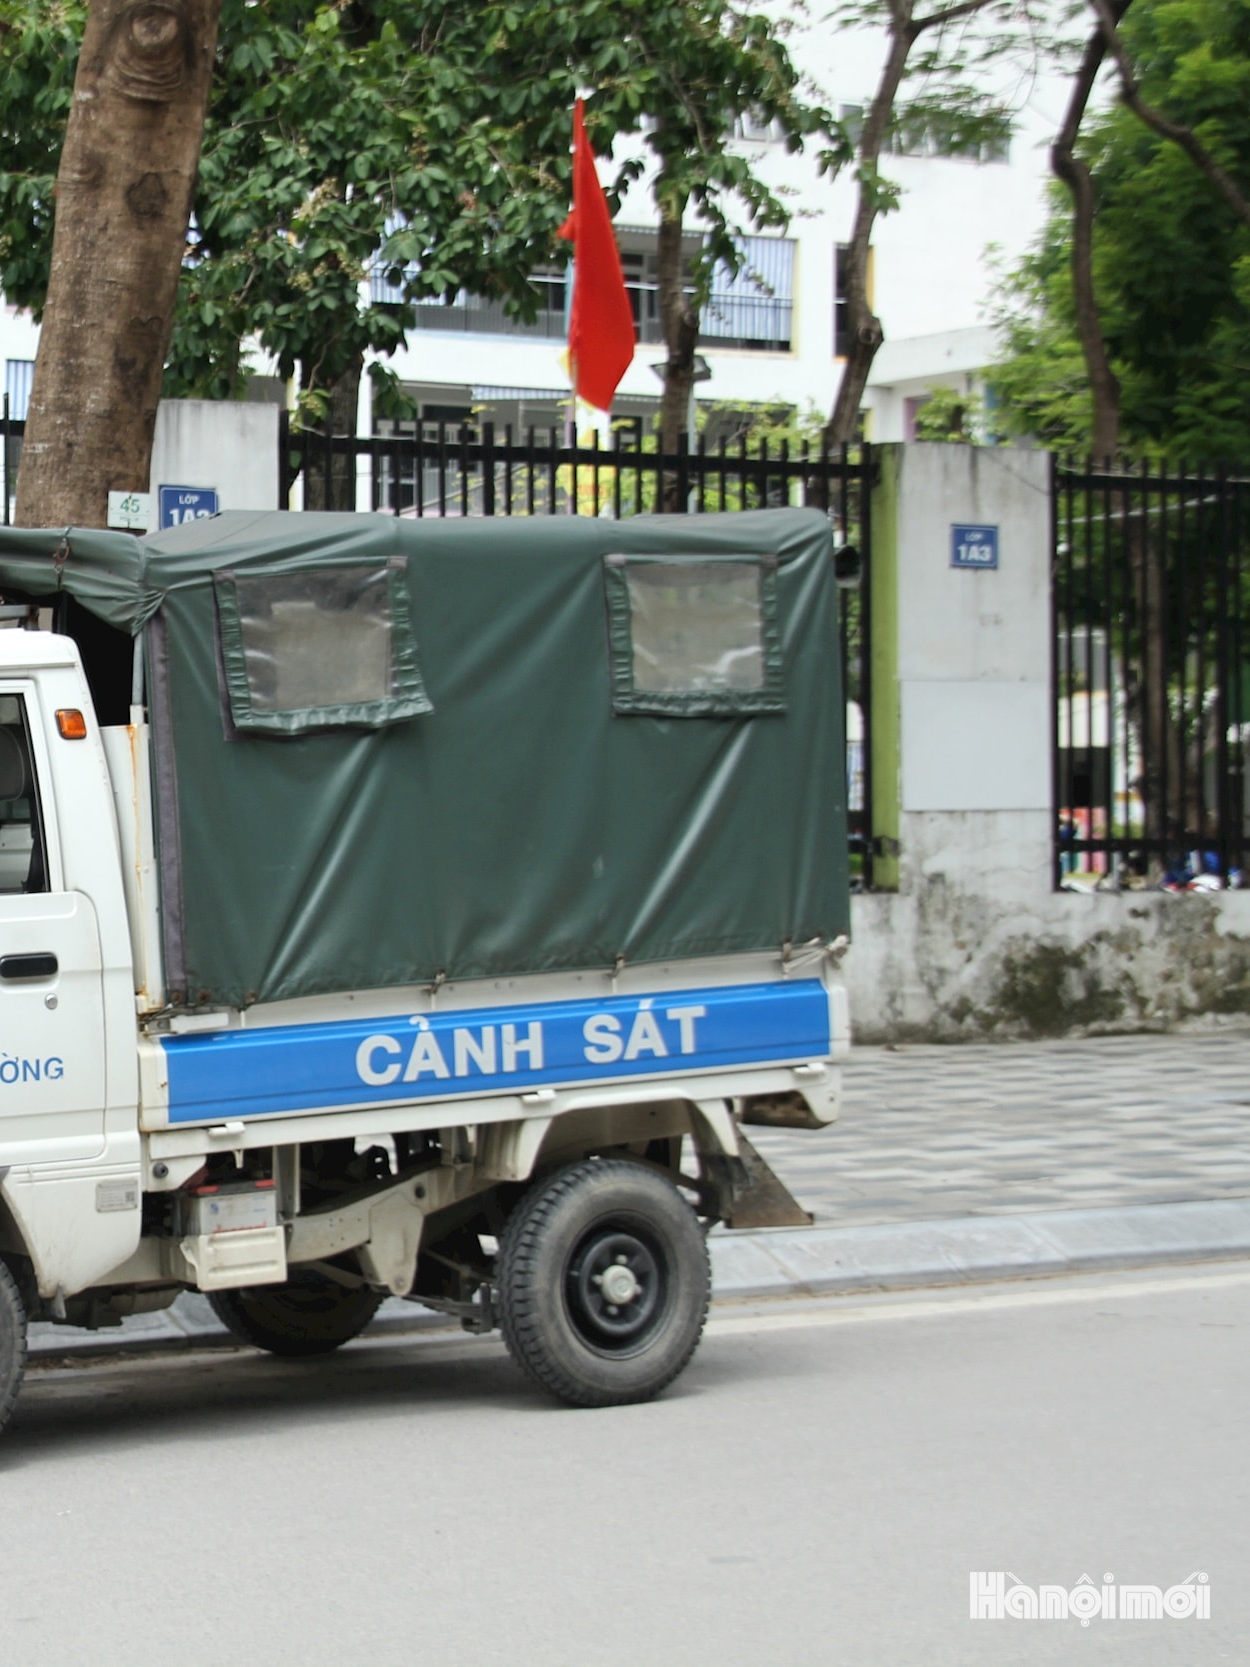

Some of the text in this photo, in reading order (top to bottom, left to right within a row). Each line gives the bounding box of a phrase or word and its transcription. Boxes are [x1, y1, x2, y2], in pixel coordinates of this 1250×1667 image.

[120, 498, 140, 513] 45
[957, 544, 992, 561] 1A3
[355, 999, 706, 1086] CẢNH SÁT
